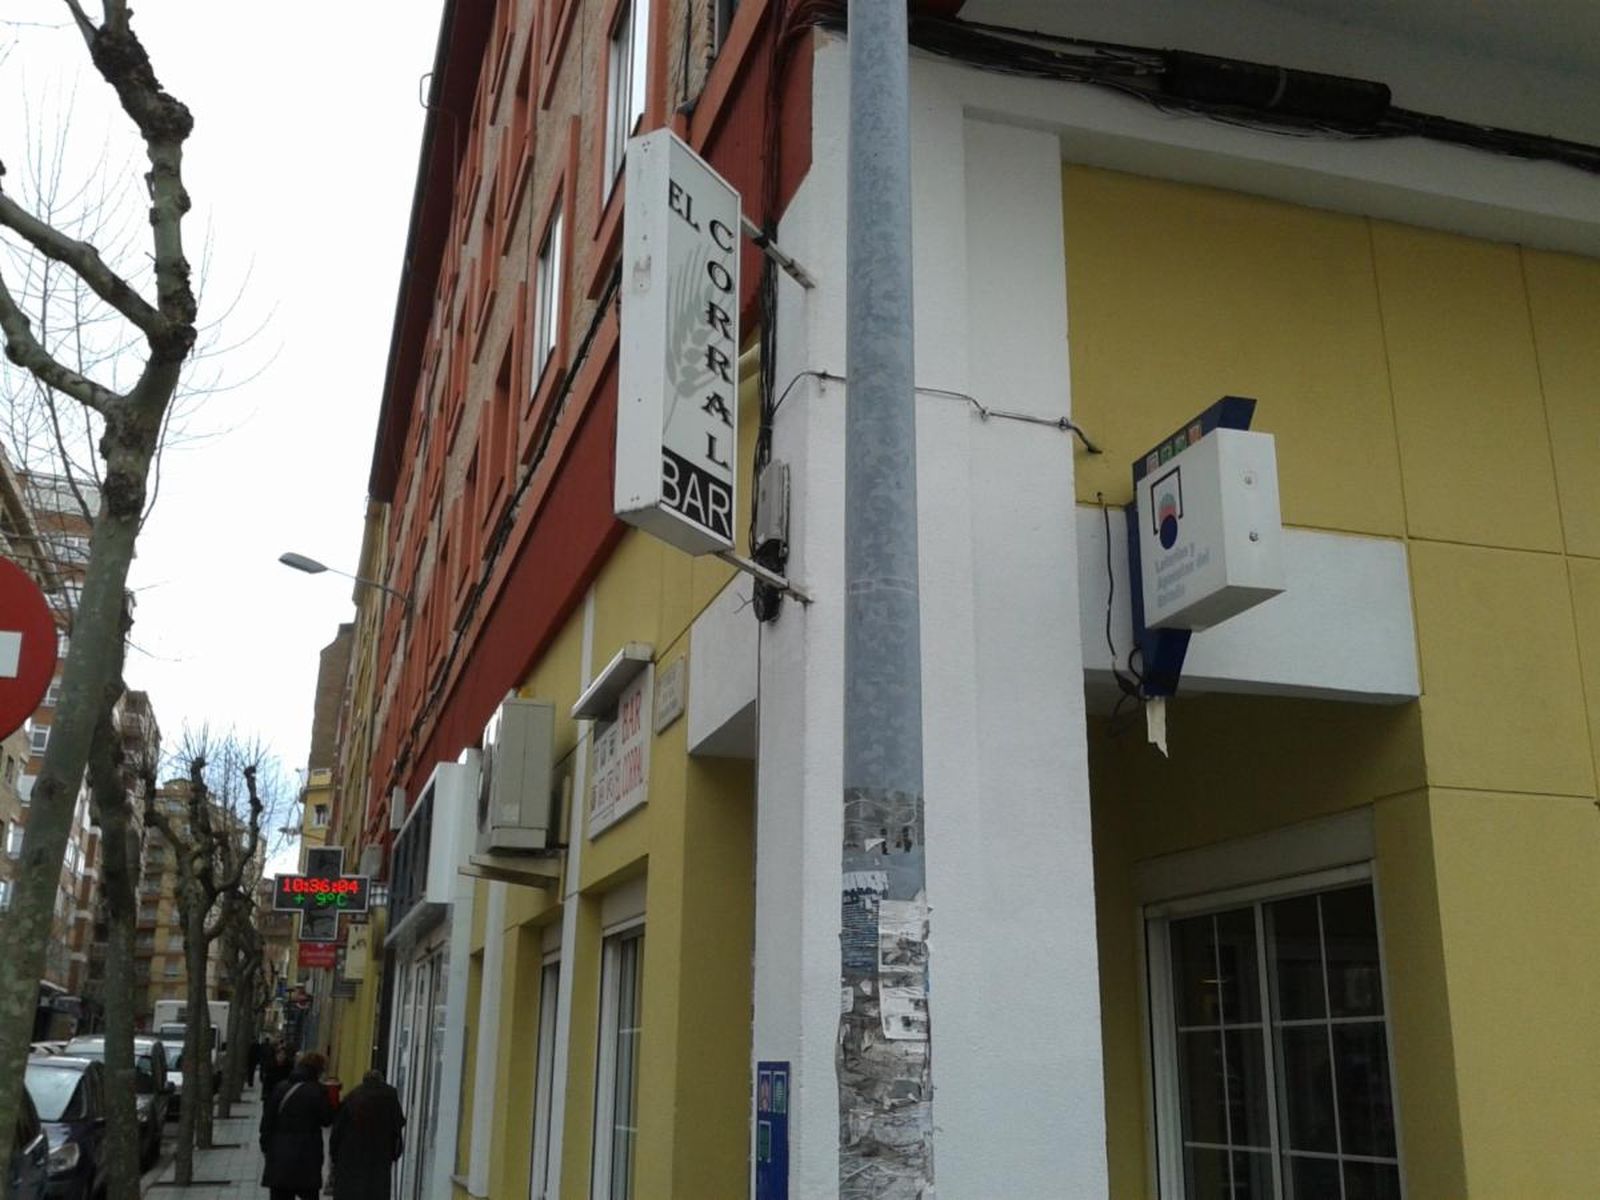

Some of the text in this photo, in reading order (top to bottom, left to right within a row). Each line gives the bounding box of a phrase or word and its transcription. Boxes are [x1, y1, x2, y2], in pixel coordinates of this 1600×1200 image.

[668, 178, 700, 233] EL
[701, 218, 734, 472] CORRAL
[661, 454, 731, 538] BAR
